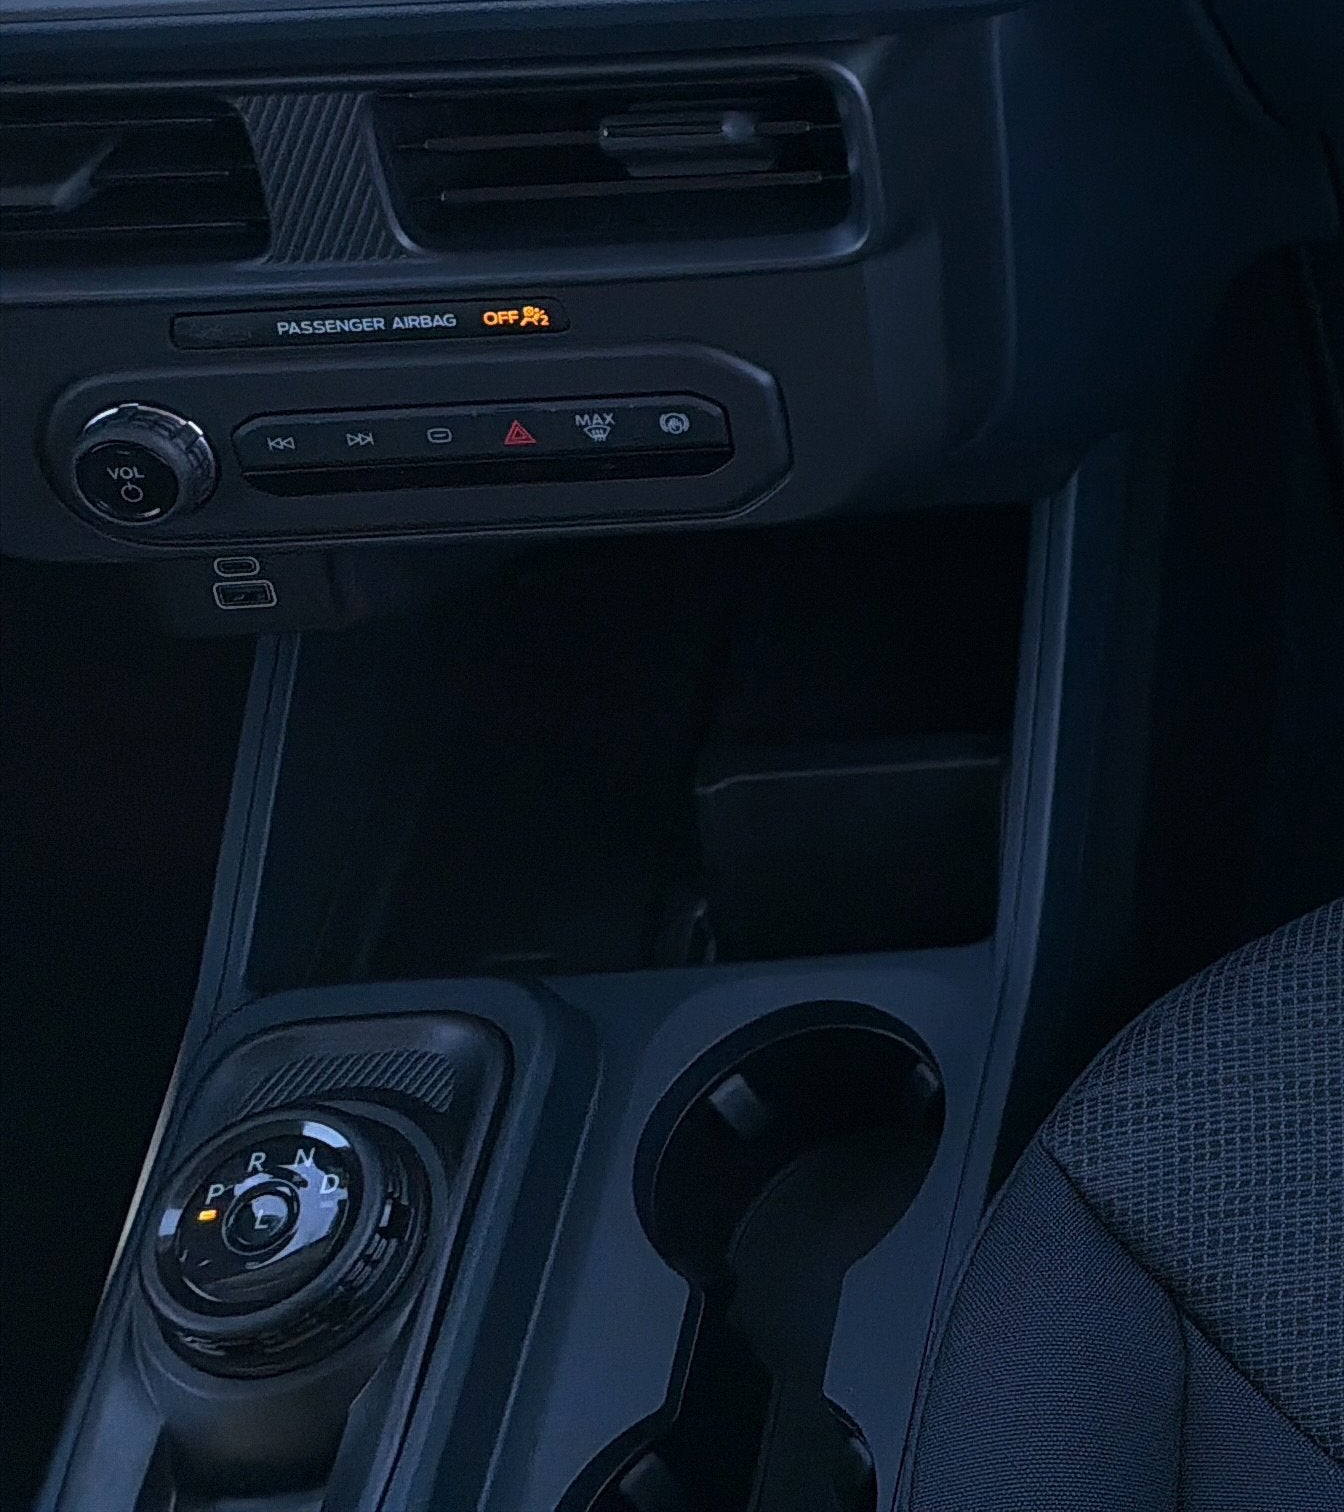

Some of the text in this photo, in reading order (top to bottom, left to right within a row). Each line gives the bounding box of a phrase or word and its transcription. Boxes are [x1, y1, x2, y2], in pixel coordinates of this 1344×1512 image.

[276, 314, 385, 336] PASSENGER
[391, 313, 457, 331] AIRBAG
[481, 310, 519, 328] OFF
[574, 412, 616, 427] MAX
[106, 466, 145, 480] VOL
[204, 1147, 340, 1205] P R N D
[254, 1209, 269, 1230] L
